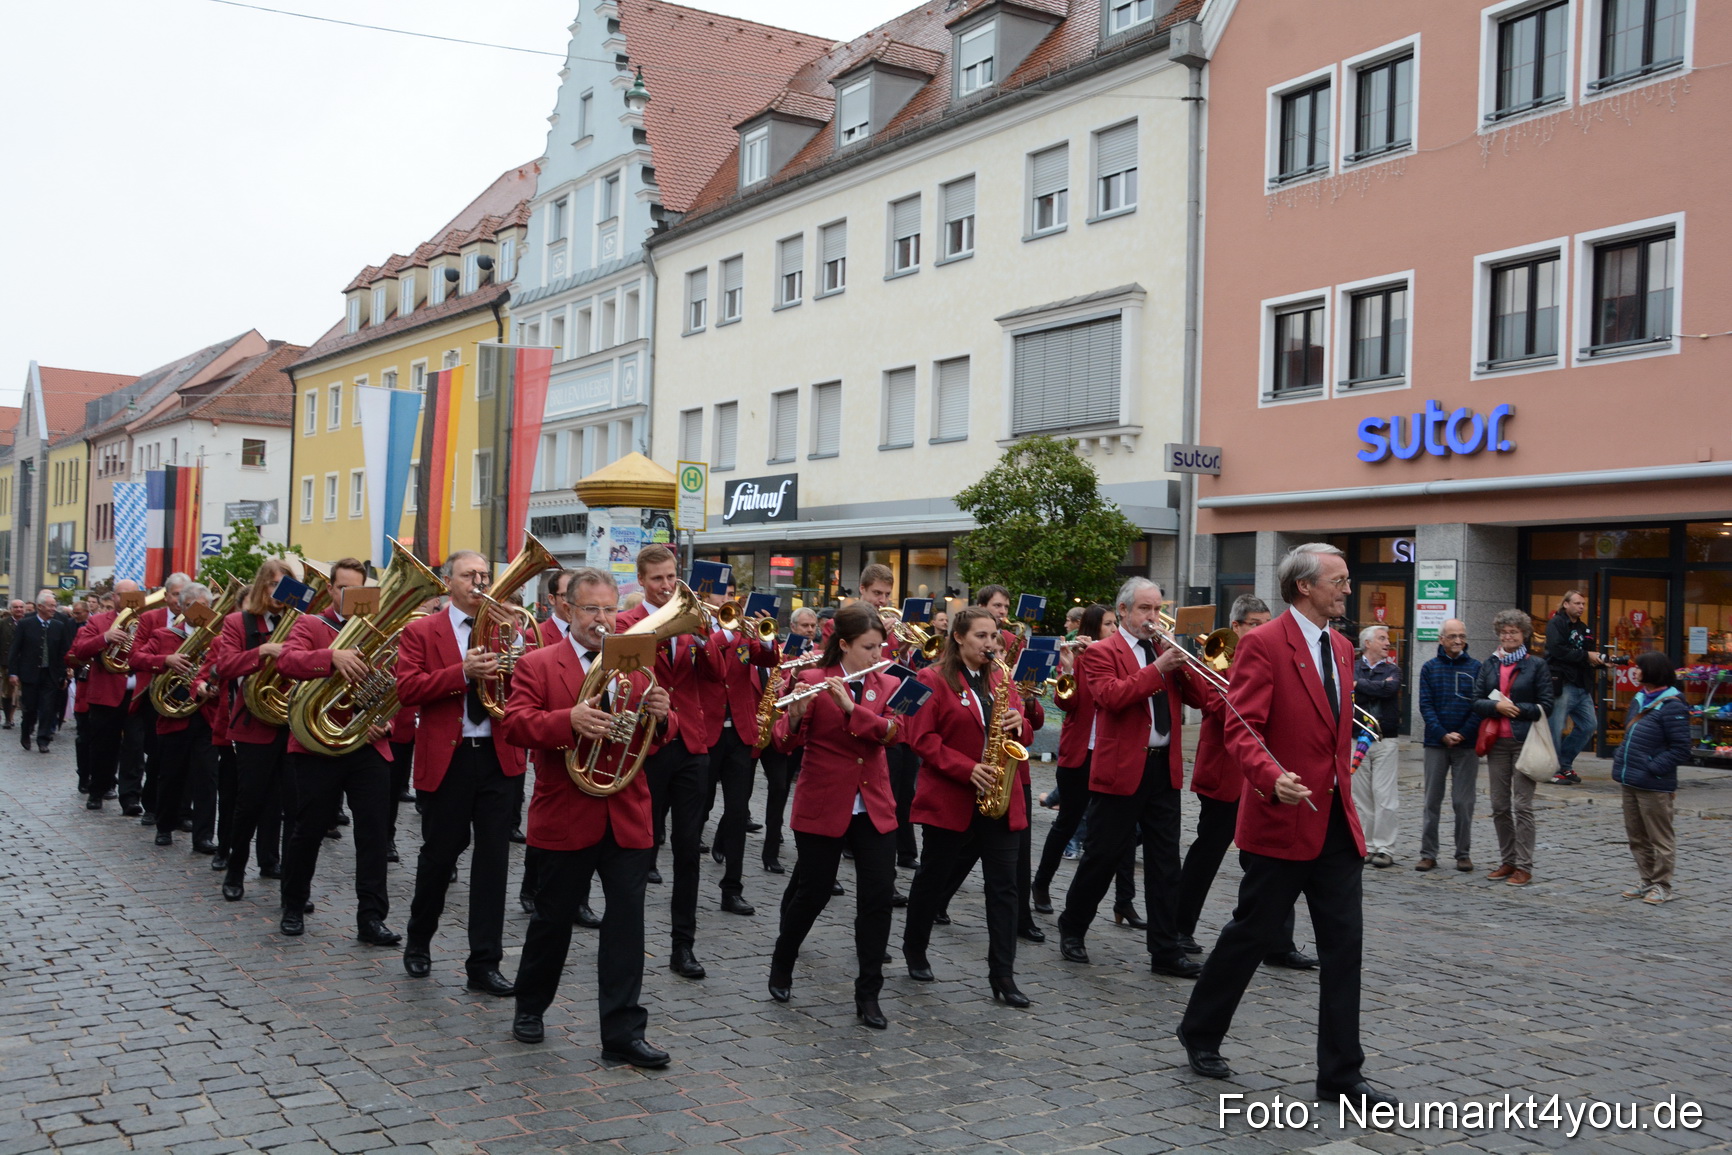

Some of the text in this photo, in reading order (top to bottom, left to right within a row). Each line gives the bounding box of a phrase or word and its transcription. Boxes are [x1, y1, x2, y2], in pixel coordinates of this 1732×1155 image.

[550, 377, 610, 408] BRILLEN WEBER
[686, 471, 698, 488] H
[723, 479, 793, 520] frühauf
[531, 515, 561, 537] BRILLEN
